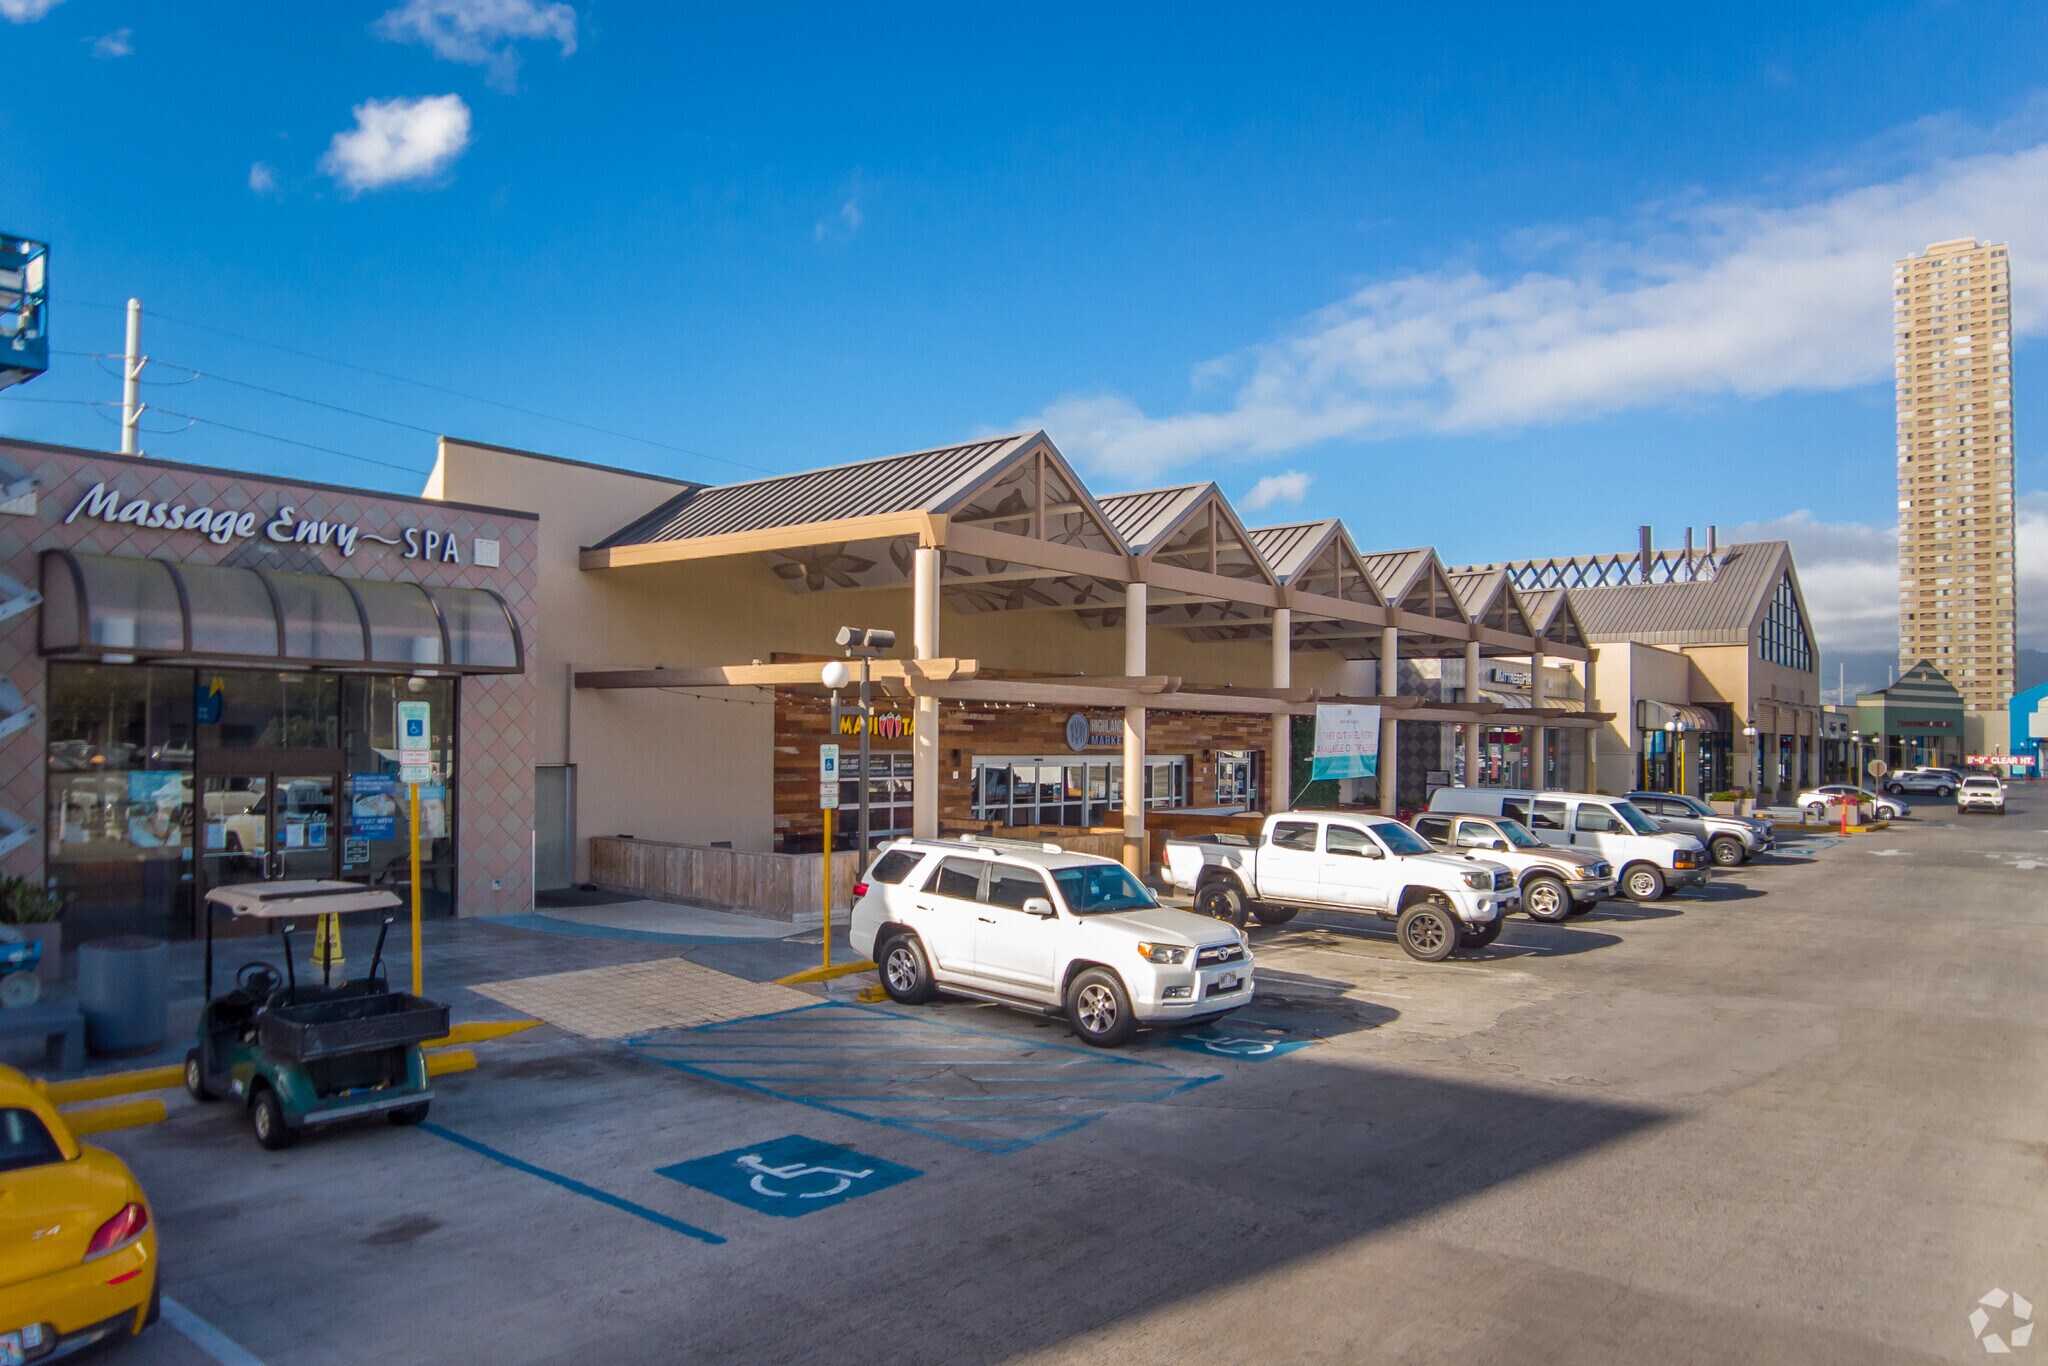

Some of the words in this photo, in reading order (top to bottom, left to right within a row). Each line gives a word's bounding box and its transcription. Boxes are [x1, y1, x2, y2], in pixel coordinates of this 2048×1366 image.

[64, 482, 256, 544] Massage
[266, 506, 359, 557] Envy
[403, 527, 460, 563] SPA
[1091, 735, 1123, 746] MARKE
[1336, 731, 1348, 740] OUT
[1990, 756, 2018, 765] CLEAR
